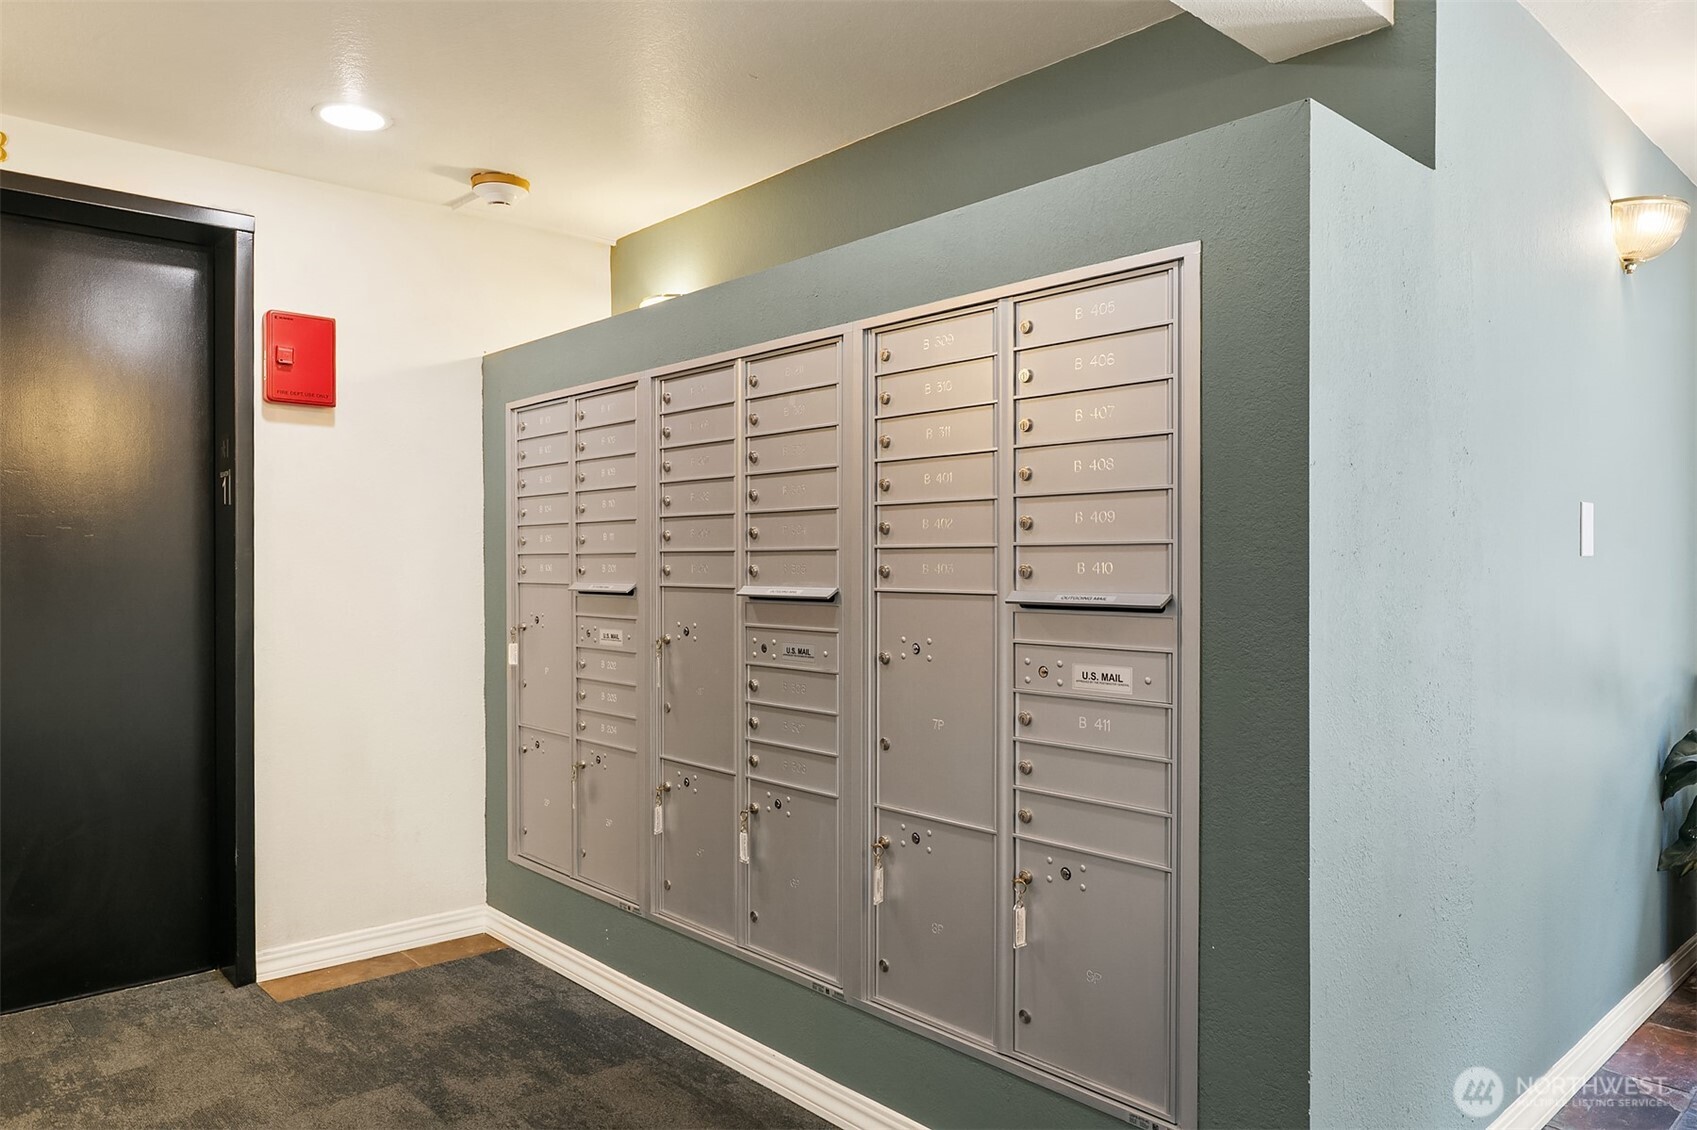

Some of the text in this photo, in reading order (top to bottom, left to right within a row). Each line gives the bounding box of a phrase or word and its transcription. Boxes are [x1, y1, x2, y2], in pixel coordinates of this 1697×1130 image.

[1075, 301, 1116, 320] B 405
[923, 338, 930, 350] B
[1074, 352, 1116, 370] B 406
[924, 379, 953, 394] B 310
[1075, 404, 1115, 422] B 407
[926, 425, 951, 440] B 311
[1074, 457, 1114, 472] B 408
[924, 471, 953, 485] B 401
[923, 517, 953, 529] B 402
[1075, 510, 1116, 524] B 409
[922, 563, 930, 575] B
[1077, 561, 1114, 575] B 410
[786, 646, 797, 655] U.S.
[797, 647, 811, 656] MAIL
[1081, 671, 1099, 681] U.S.
[1101, 672, 1124, 683] MAIL
[932, 718, 945, 730] 7P
[1079, 716, 1111, 732] B 411
